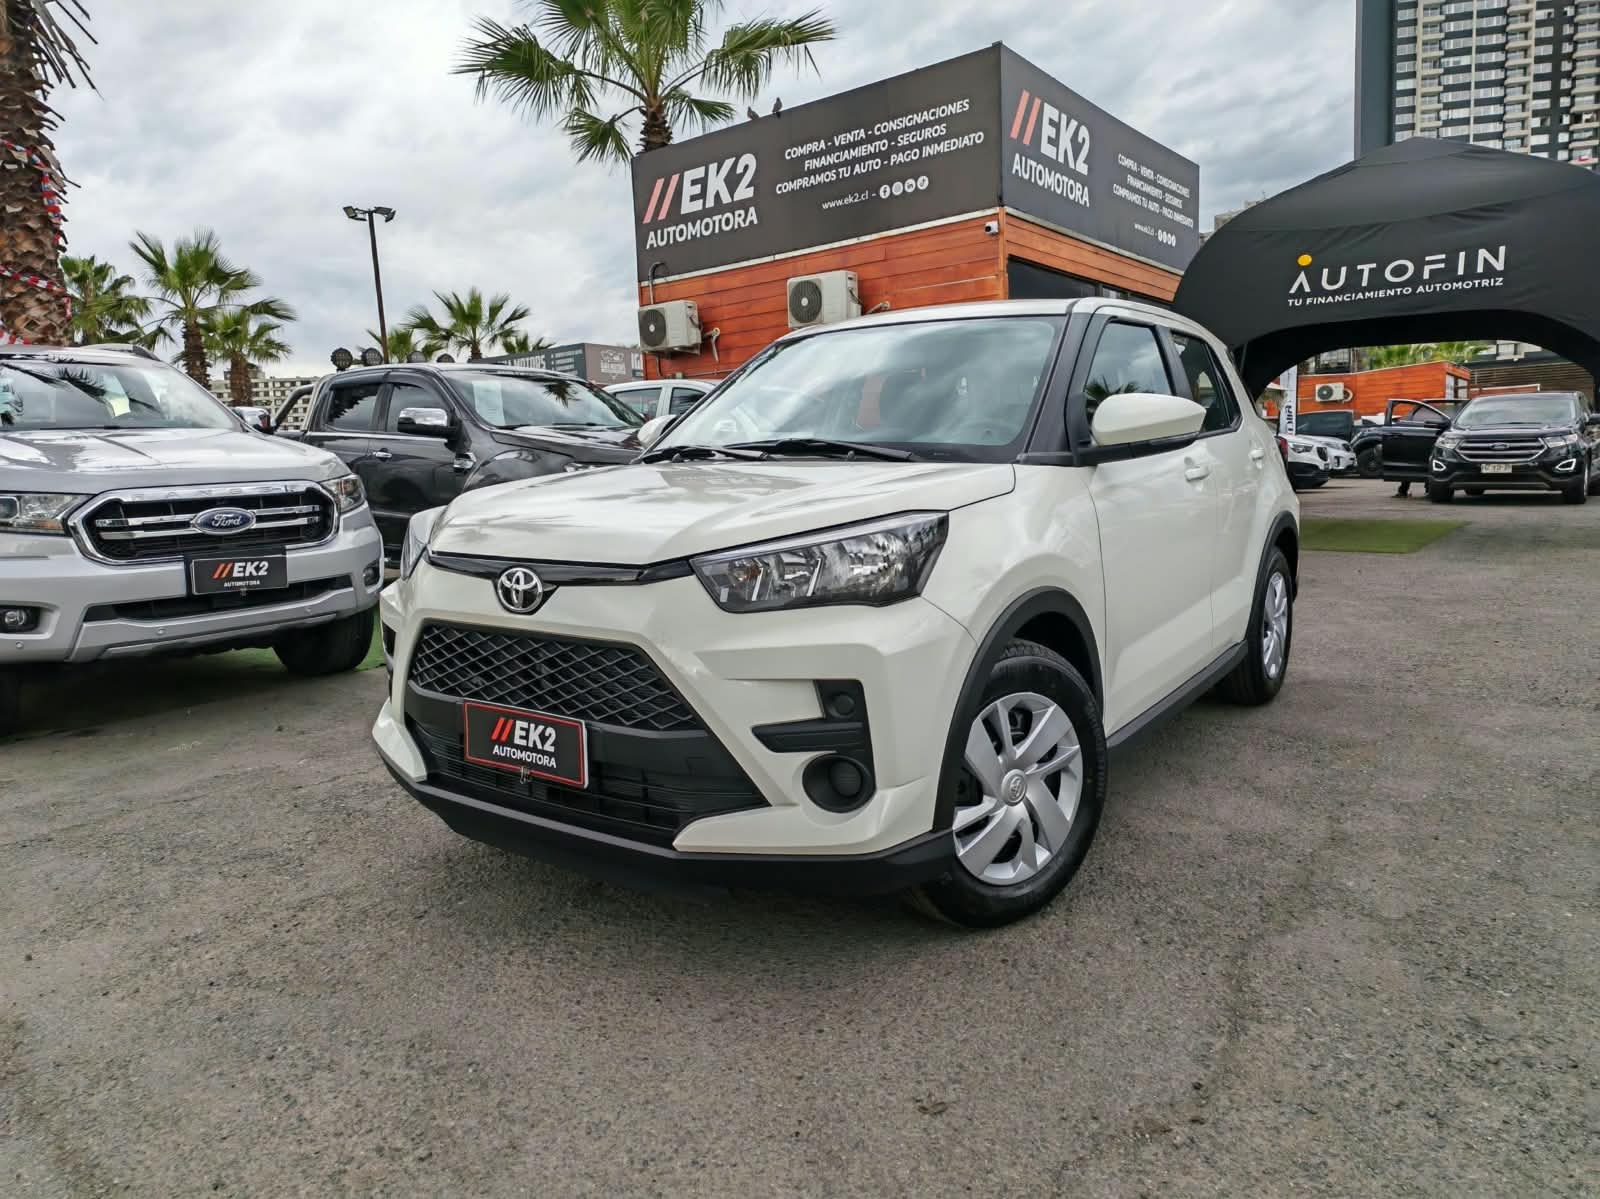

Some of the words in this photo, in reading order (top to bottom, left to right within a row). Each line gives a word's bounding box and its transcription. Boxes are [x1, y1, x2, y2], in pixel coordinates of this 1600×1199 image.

[785, 139, 826, 160] COMPRA
[834, 128, 866, 147] VENTA
[874, 98, 970, 136] CONSIGNACIONES
[804, 139, 888, 171] FINANCIAMIENTO
[897, 123, 947, 146] SEGUROS
[775, 169, 836, 194] COMPRAMOS
[838, 166, 851, 179] TU
[853, 158, 881, 176] AUTO
[890, 148, 920, 166] PAGO
[922, 131, 985, 158] INMEDIATO
[1012, 153, 1090, 208] AUTOMOTORA
[822, 190, 869, 209] www.ek2.cl
[647, 206, 758, 249] AUTOMOTORA
[1288, 298, 1303, 307] TU
[1305, 287, 1412, 305] FINANCIAMIENTO
[1416, 277, 1505, 295] AUTOMOTRIZ
[1289, 245, 1506, 294] AUTOFIN
[212, 513, 242, 527] Ford
[492, 745, 557, 769] AUTOMOTORA
